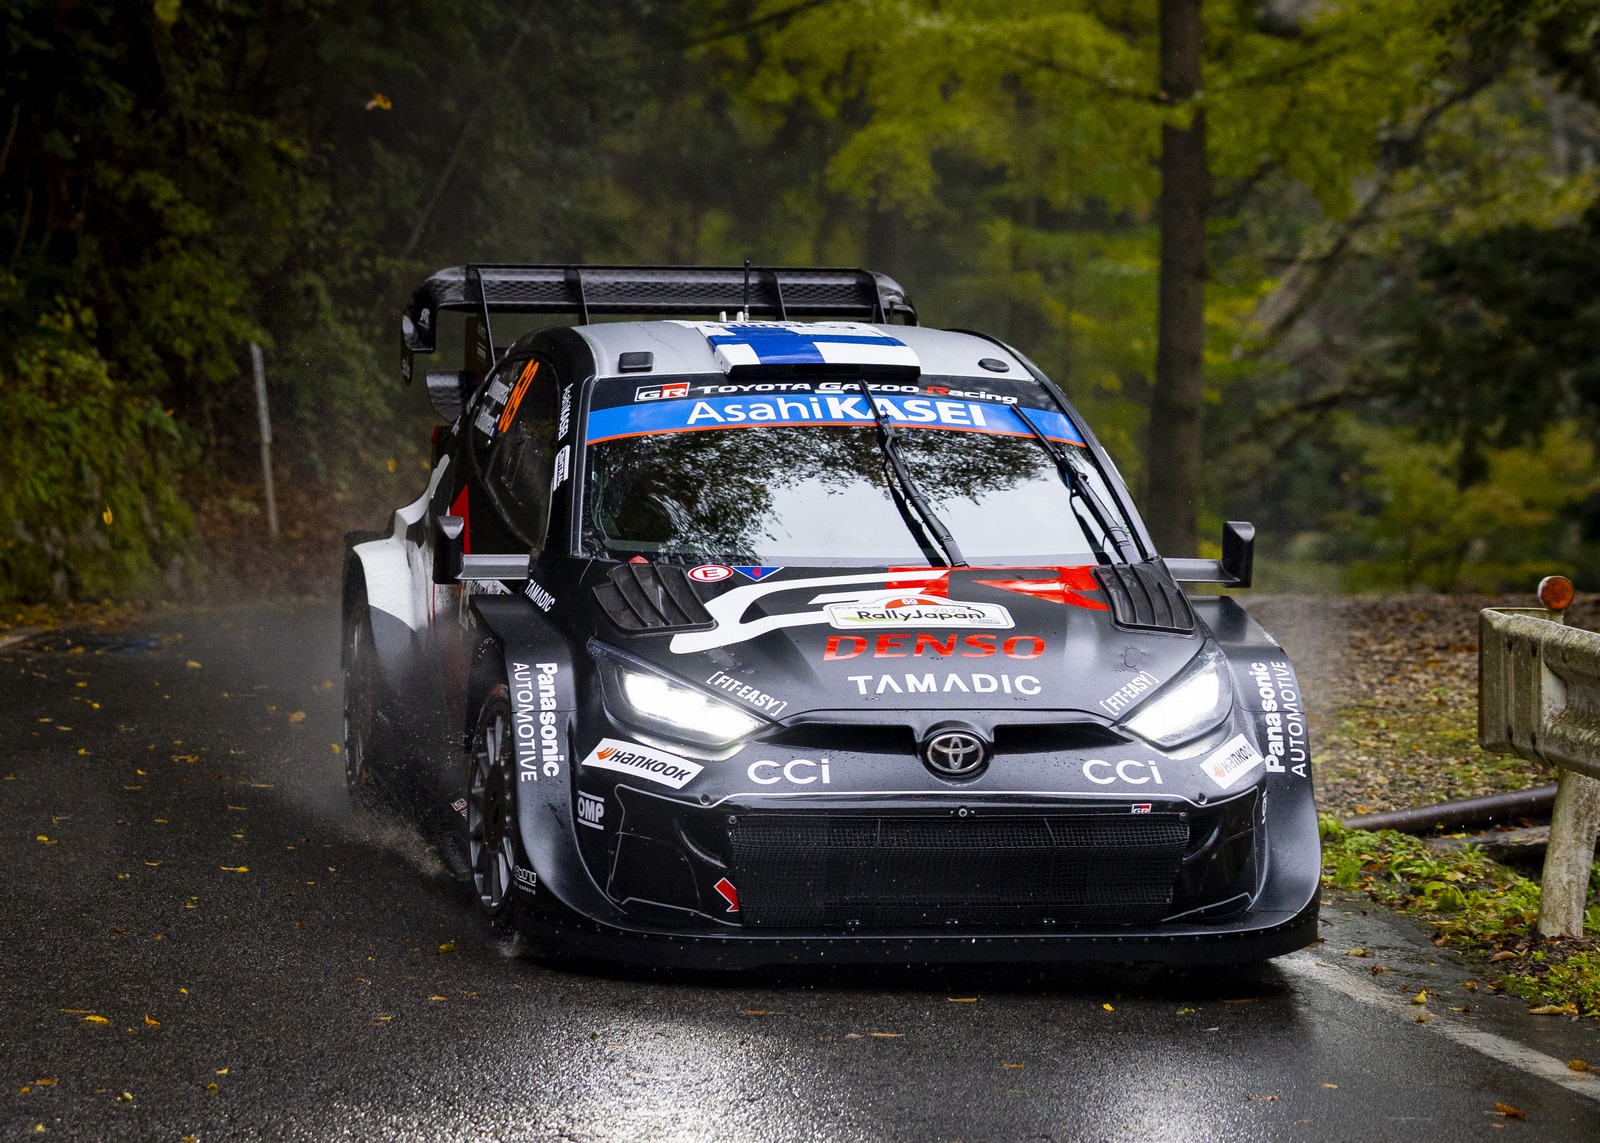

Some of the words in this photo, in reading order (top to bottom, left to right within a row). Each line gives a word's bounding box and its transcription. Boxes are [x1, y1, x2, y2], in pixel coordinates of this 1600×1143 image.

[638, 388, 686, 399] GR
[697, 383, 811, 394] TOYOTA
[926, 386, 1018, 404] Racing
[524, 578, 556, 613] TAMADIC
[823, 633, 1047, 661] DENSO
[847, 673, 1042, 695] TAMADIC
[512, 662, 538, 783] AUTOMOTIVE
[535, 662, 565, 778] Panasonic
[1249, 662, 1286, 773] Panasonic
[1270, 661, 1307, 778] AUTOMOTIVE
[577, 796, 605, 824] OMP
